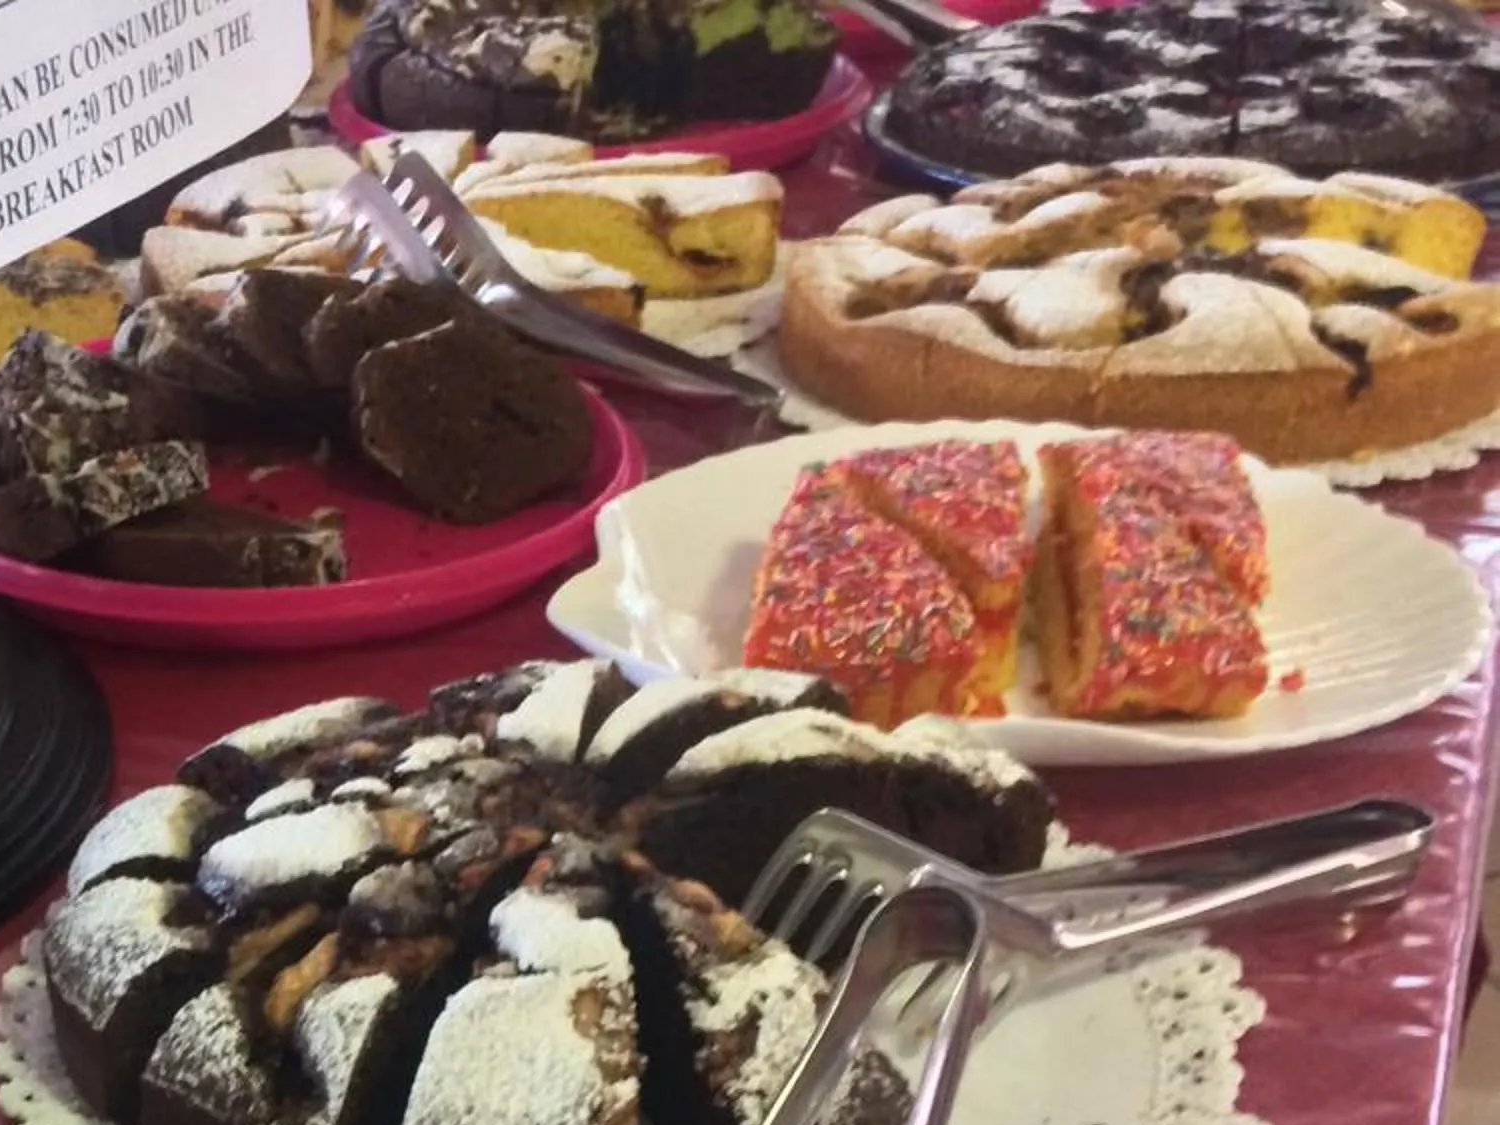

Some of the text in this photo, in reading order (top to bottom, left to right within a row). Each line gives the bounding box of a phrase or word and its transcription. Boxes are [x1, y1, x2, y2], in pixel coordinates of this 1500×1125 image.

[35, 55, 65, 98] BE
[68, 0, 186, 79] CONSUMED
[62, 93, 102, 137] 7:30
[105, 73, 134, 117] TO
[138, 49, 184, 99] 10:30
[188, 36, 211, 72] IN
[216, 12, 254, 58] THE
[131, 95, 195, 159] ROOM
